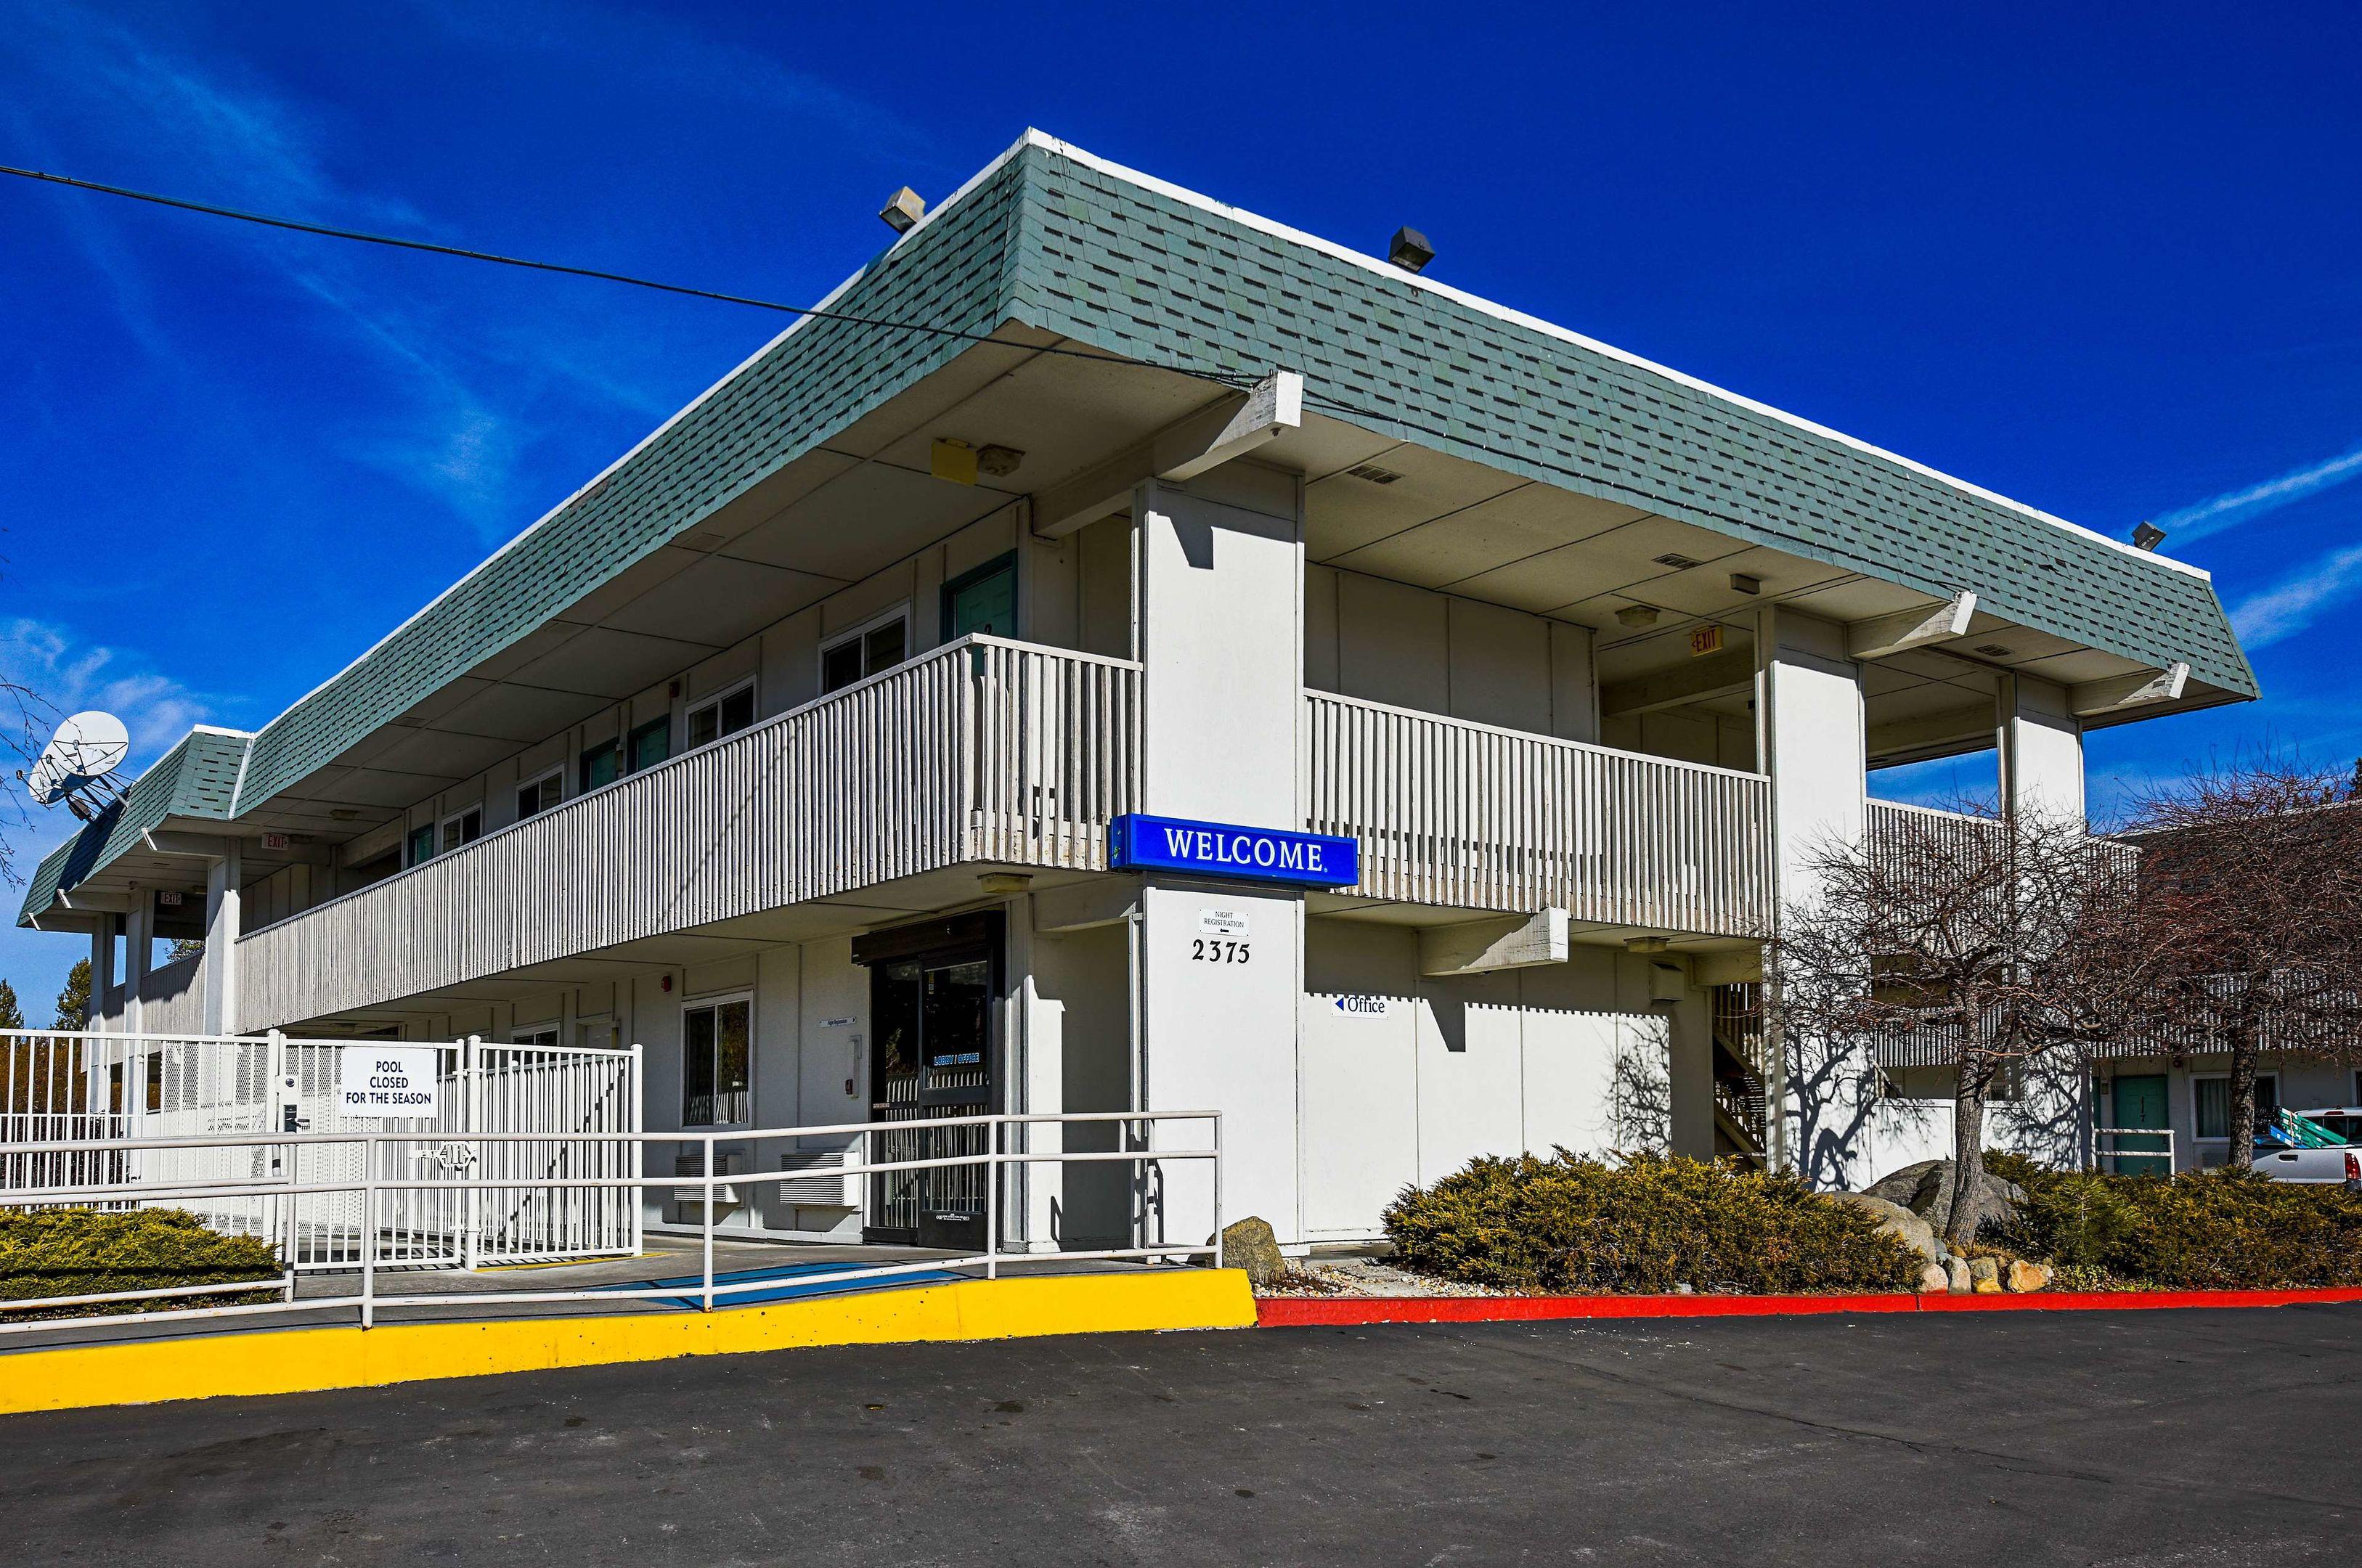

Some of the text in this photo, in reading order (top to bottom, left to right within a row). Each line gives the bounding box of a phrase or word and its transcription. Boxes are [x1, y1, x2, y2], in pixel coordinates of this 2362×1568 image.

[1696, 628, 1716, 653] EXIT
[268, 835, 285, 848] EXIT
[164, 893, 179, 904] EXIT
[1204, 918, 1244, 928] REGISTRATION
[1192, 939, 1250, 964] 2375
[1348, 997, 1385, 1013] Office
[934, 1054, 954, 1066] LOBBY
[958, 1053, 980, 1063] OFFICE
[376, 1061, 403, 1073] POOL
[370, 1077, 409, 1088] CLOSED
[346, 1092, 431, 1104] FOR THE SEASON
